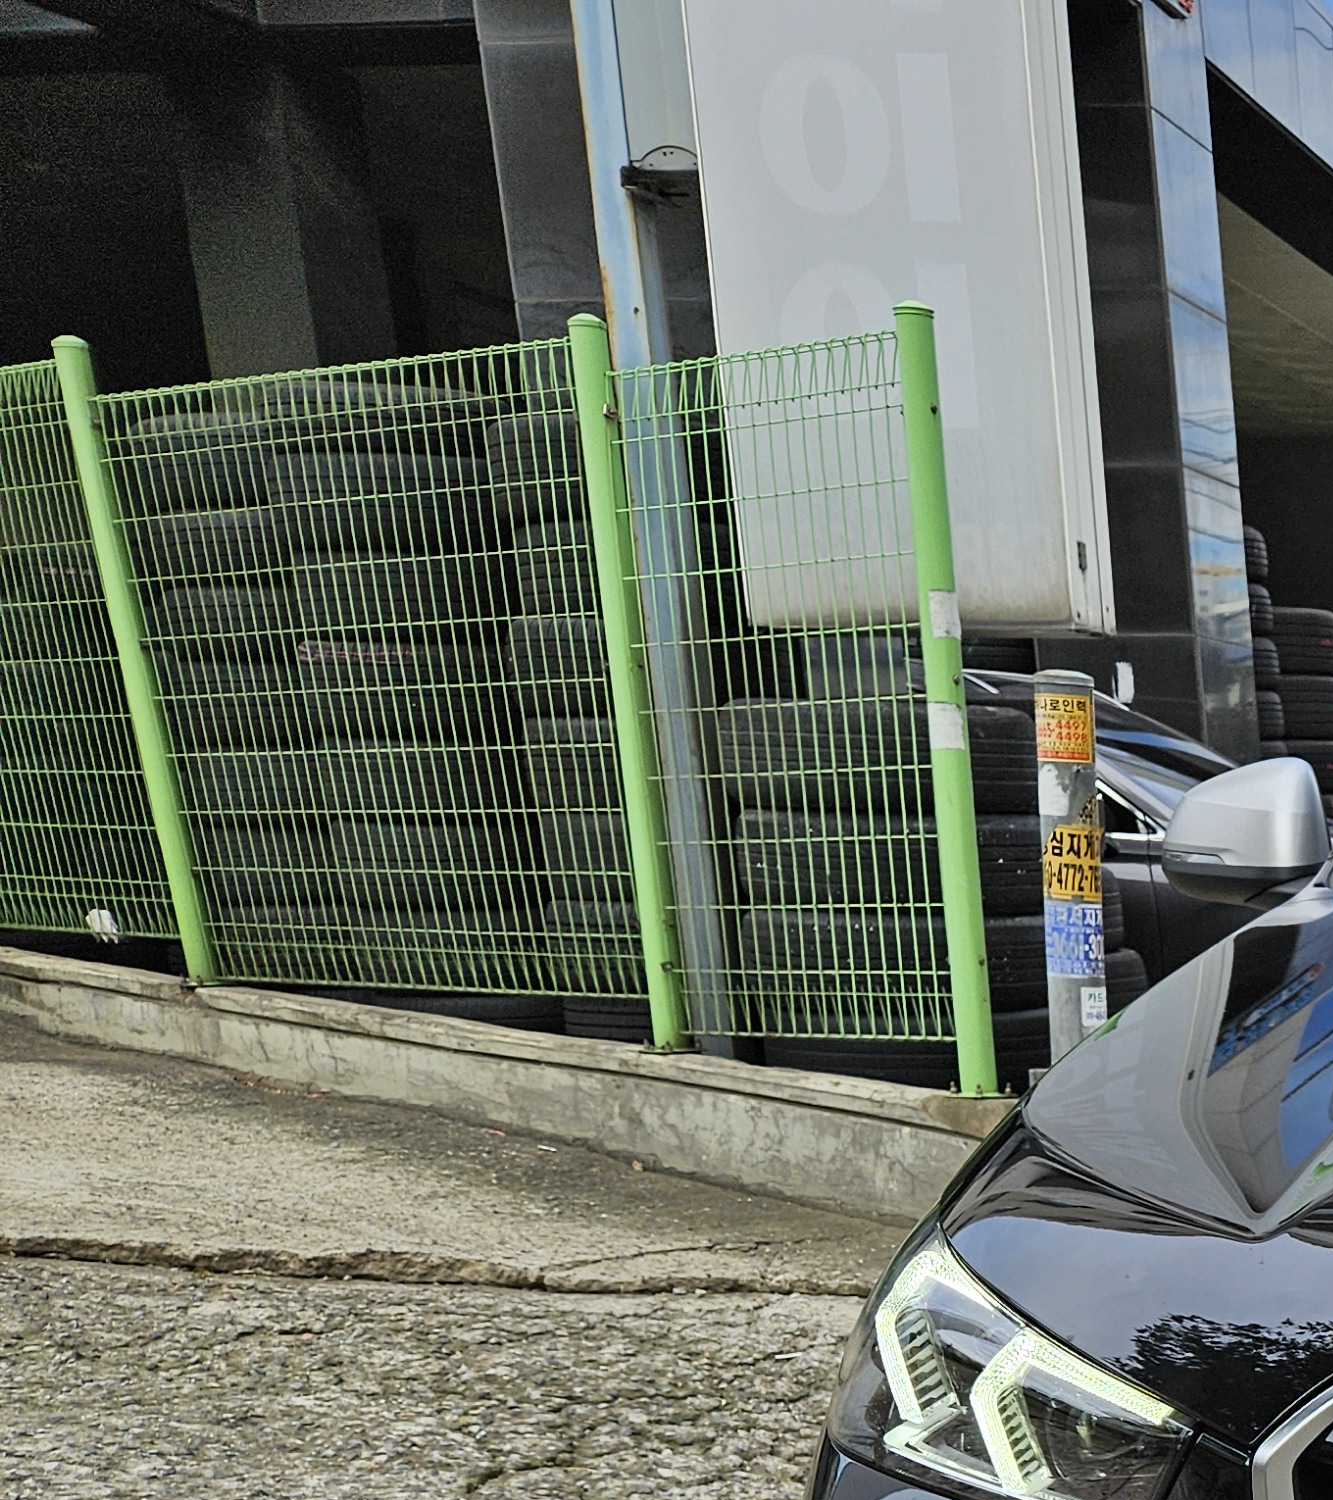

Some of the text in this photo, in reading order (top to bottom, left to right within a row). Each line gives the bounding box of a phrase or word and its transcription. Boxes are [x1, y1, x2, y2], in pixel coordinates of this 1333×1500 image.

[1035, 698, 1087, 713] 나로인력
[1055, 719, 1087, 731] 4497
[1055, 731, 1088, 743] 4498
[1043, 831, 1100, 860] 심지게
